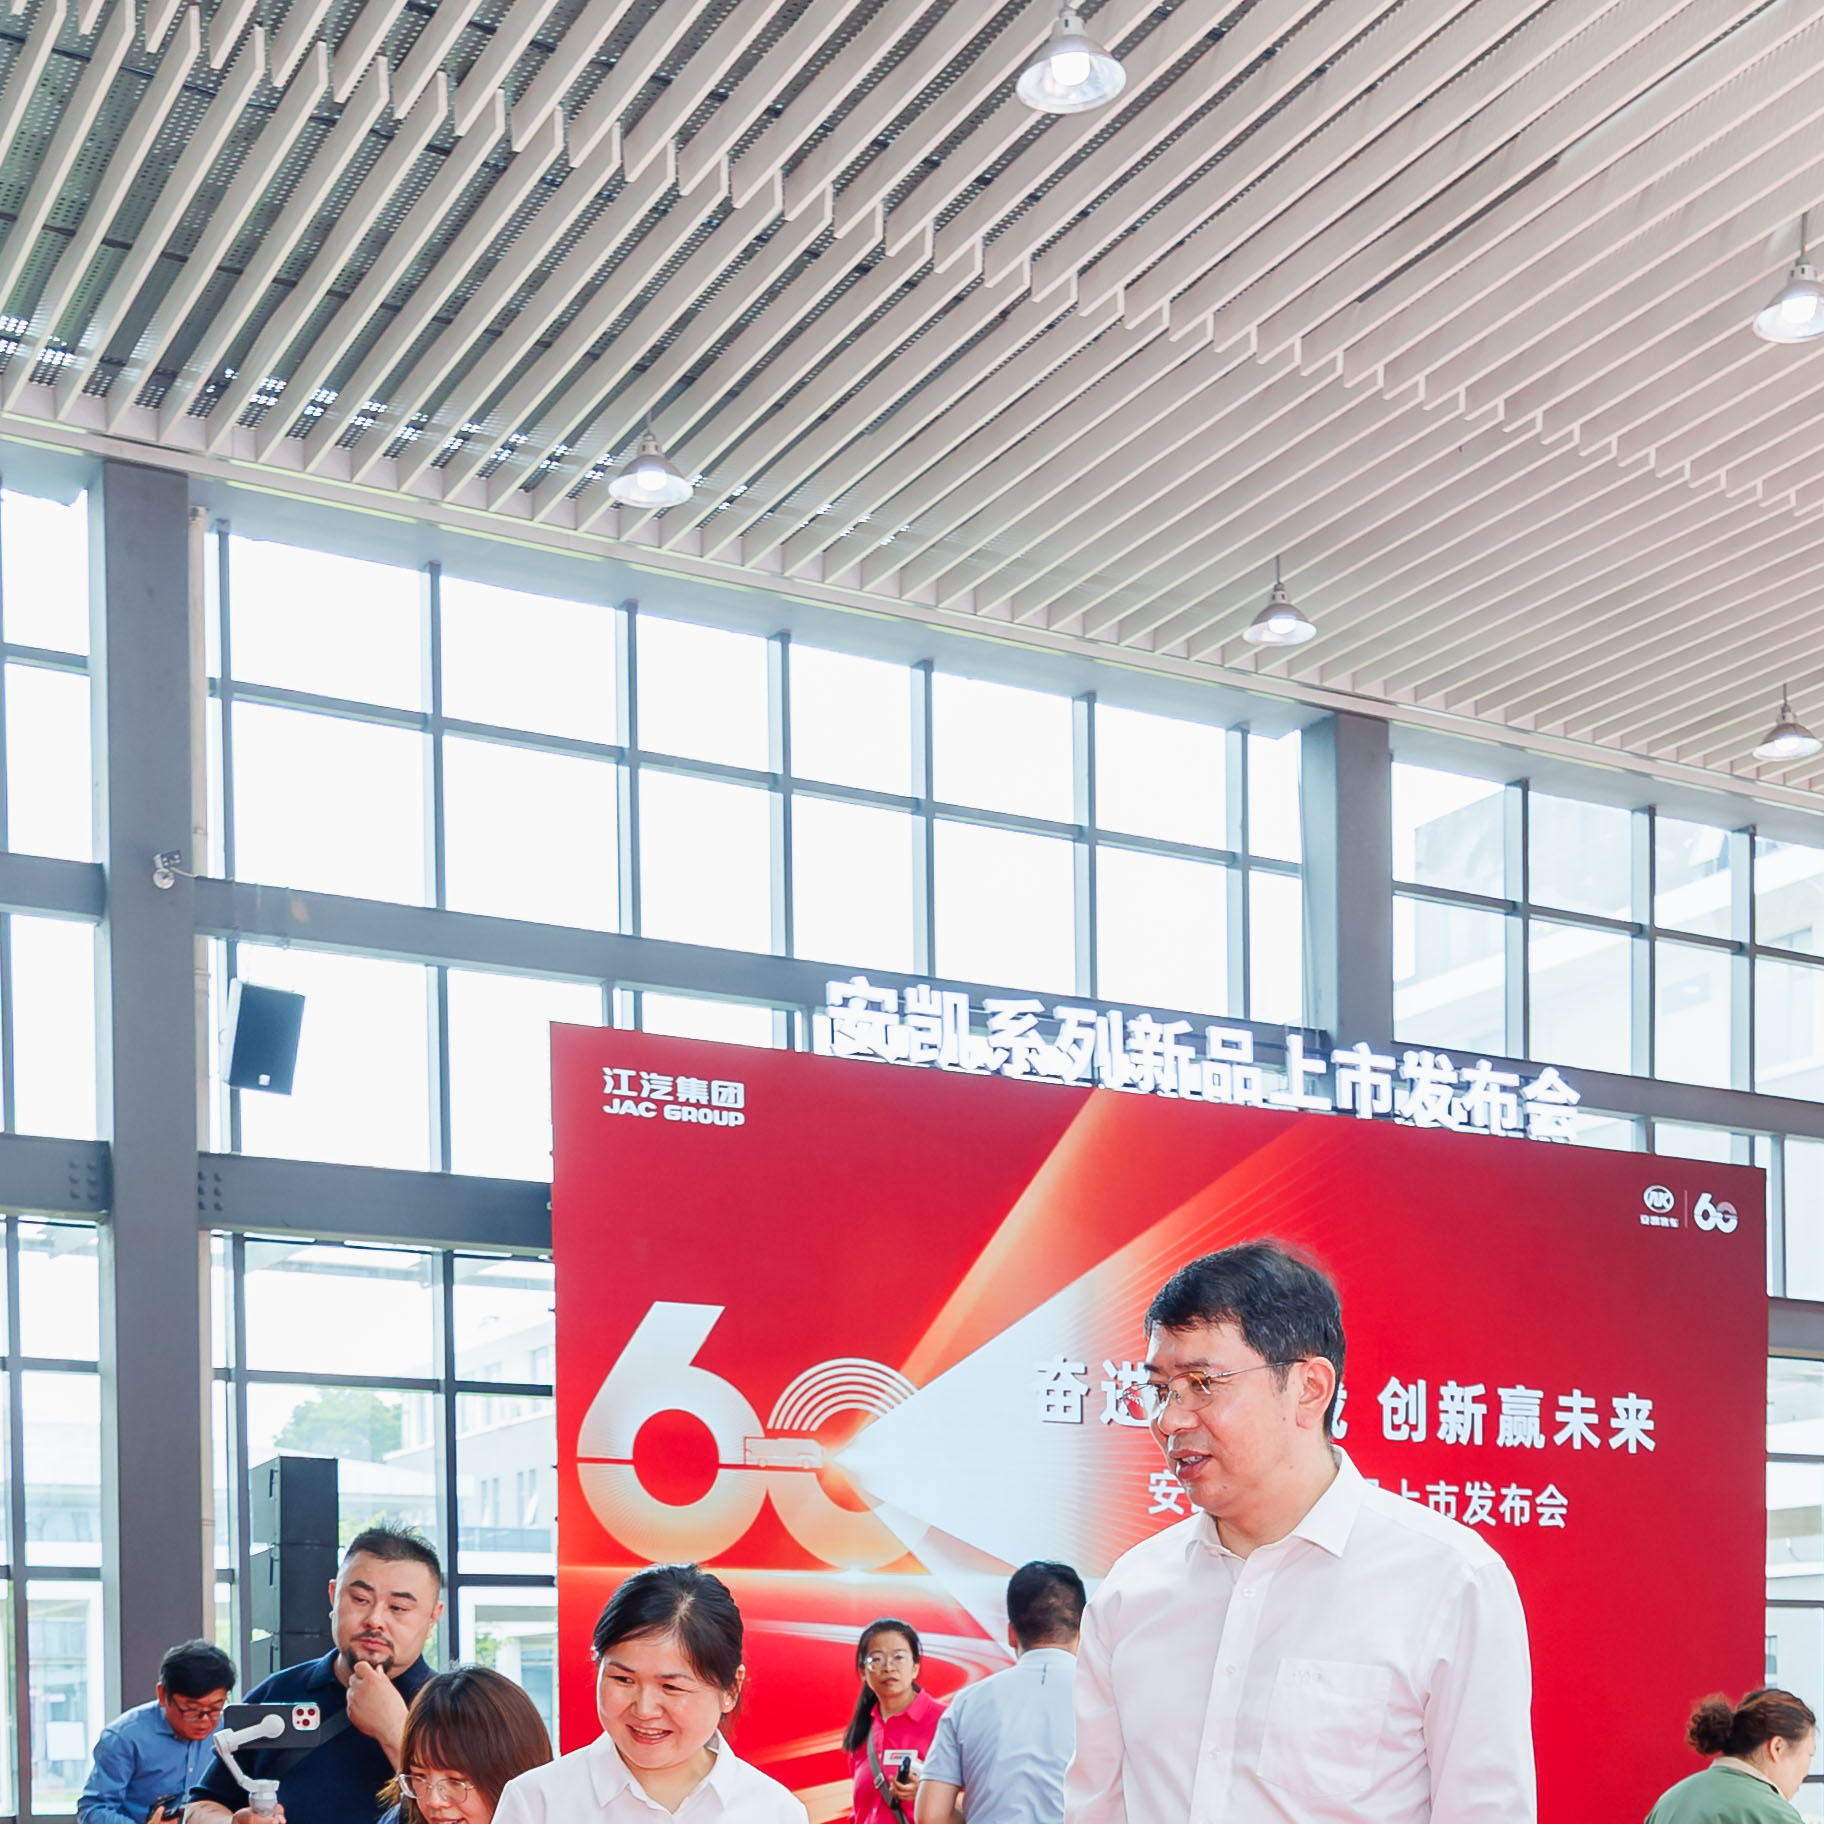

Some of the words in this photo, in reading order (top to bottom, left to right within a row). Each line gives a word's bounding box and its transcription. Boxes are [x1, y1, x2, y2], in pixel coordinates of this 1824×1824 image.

[825, 976, 1581, 1143] 安凯系列新品上市发布会
[602, 1067, 745, 1109] 江汽集团
[602, 1098, 657, 1118] JAC
[663, 1104, 745, 1127] GROUP
[1377, 1376, 1657, 1454] 创新赢未来
[1366, 1478, 1569, 1529] 上市发布会
